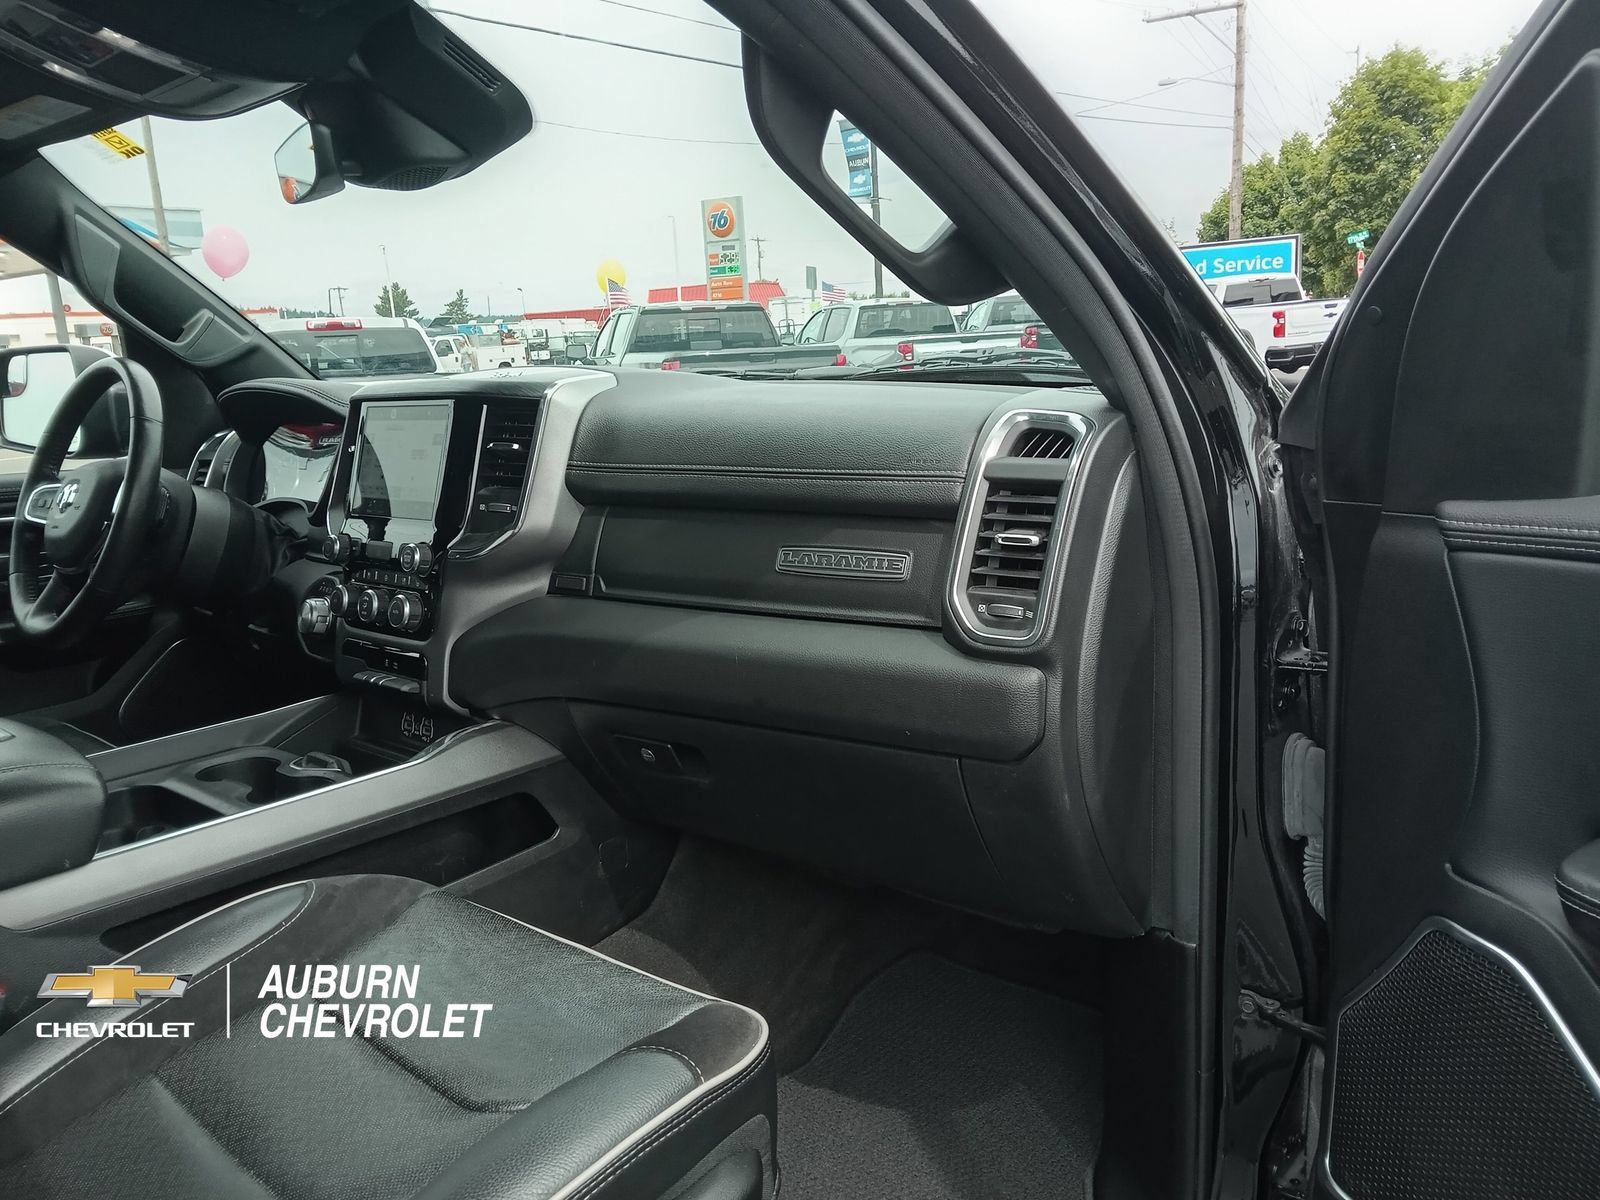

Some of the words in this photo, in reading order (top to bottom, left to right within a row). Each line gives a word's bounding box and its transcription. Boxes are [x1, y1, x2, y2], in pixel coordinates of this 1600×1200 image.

[849, 157, 869, 167] AUBURN
[710, 209, 729, 230] 76
[1213, 255, 1284, 274] Service
[781, 552, 905, 572] LARAMIE
